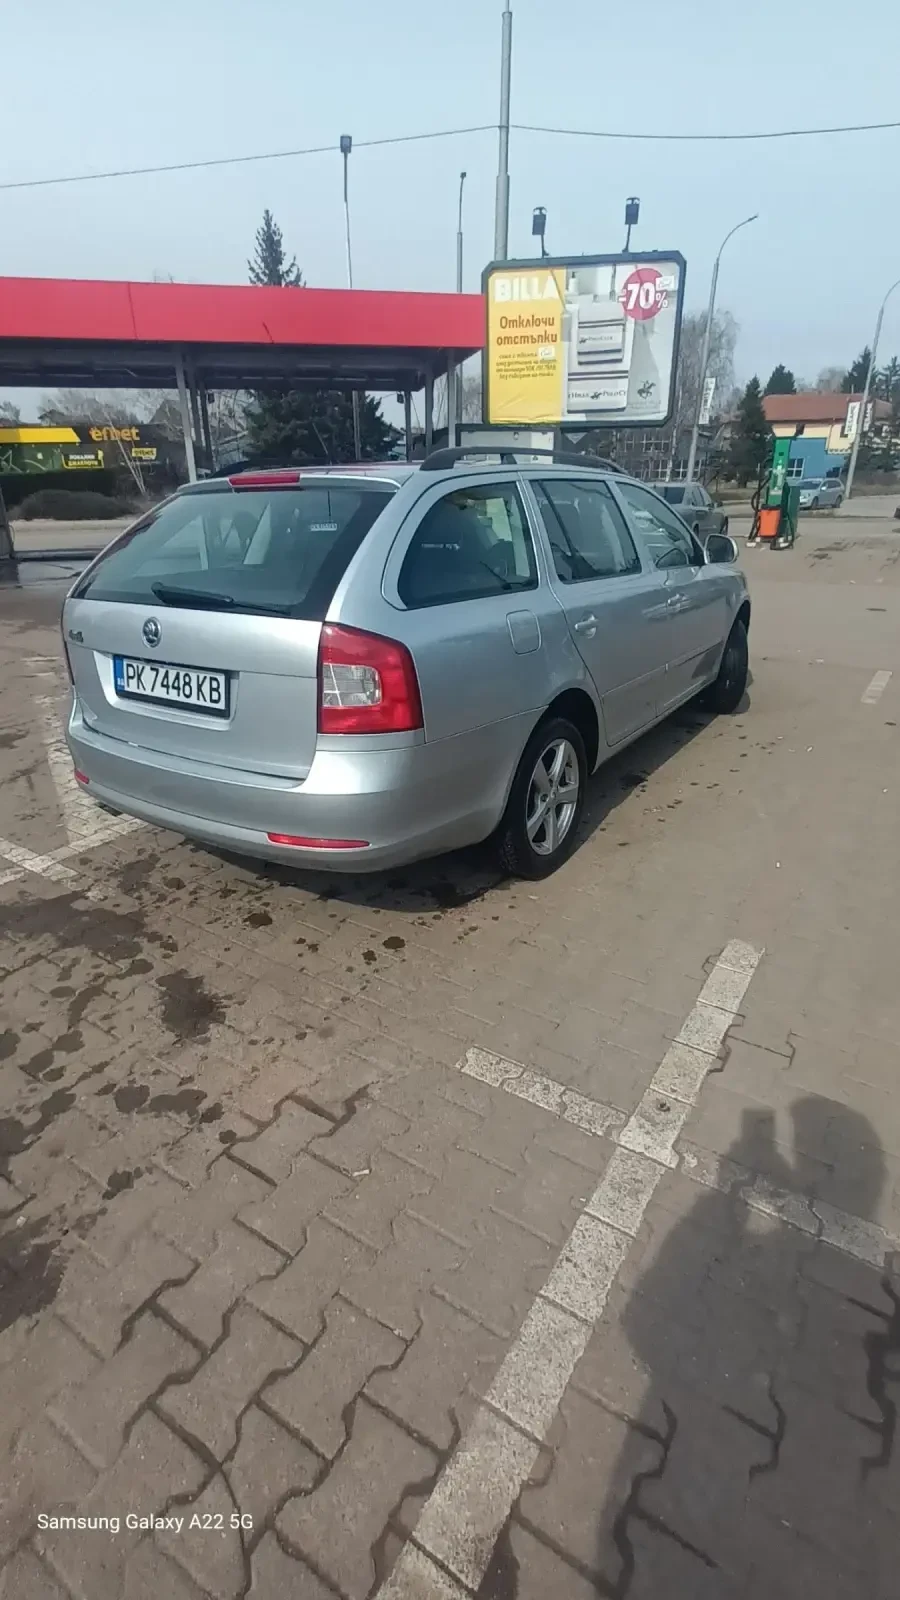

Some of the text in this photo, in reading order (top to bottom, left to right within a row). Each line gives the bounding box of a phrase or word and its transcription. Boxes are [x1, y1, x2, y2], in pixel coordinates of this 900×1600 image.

[494, 276, 560, 302] BILLA
[618, 282, 668, 310] -70%
[500, 314, 555, 330] Отключи
[496, 330, 558, 346] отстъпки
[90, 426, 140, 441] efbet
[126, 663, 222, 704] PK 7448 KB
